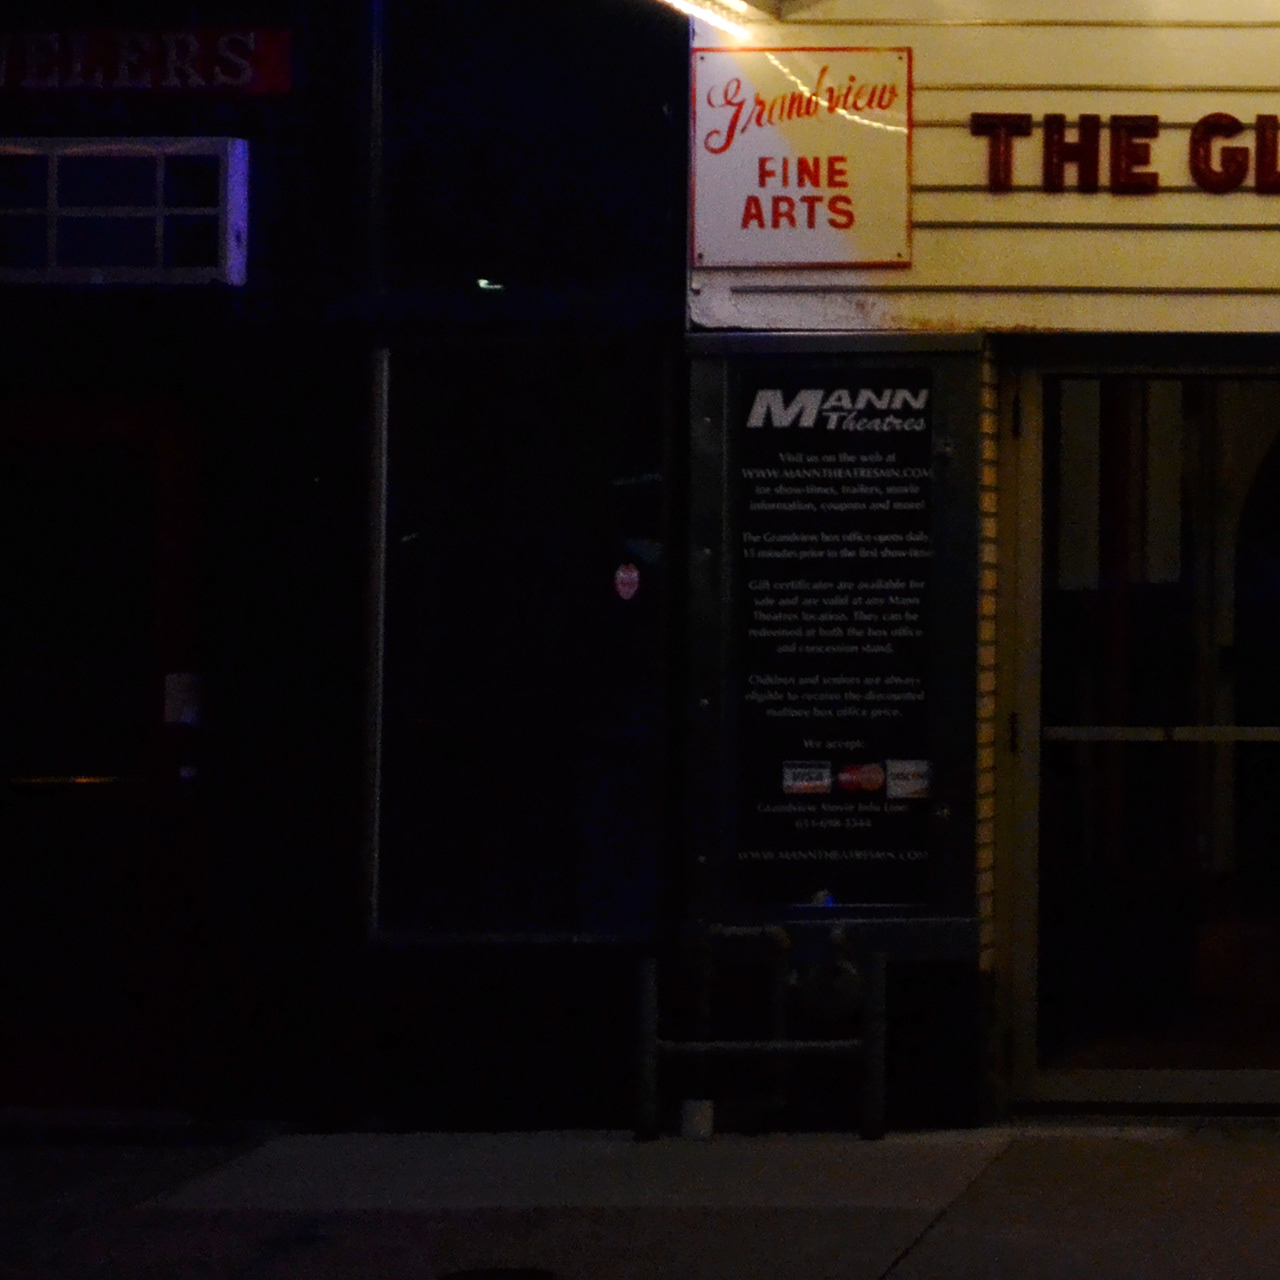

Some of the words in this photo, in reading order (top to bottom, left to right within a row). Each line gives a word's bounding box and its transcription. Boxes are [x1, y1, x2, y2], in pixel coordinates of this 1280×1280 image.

[0, 31, 255, 89] ELERS
[704, 65, 898, 154] Grandview
[758, 156, 849, 188] FINE
[970, 112, 1160, 194] THE
[741, 195, 855, 230] ARTS
[746, 388, 930, 429] MANN
[820, 411, 927, 432] Theatres
